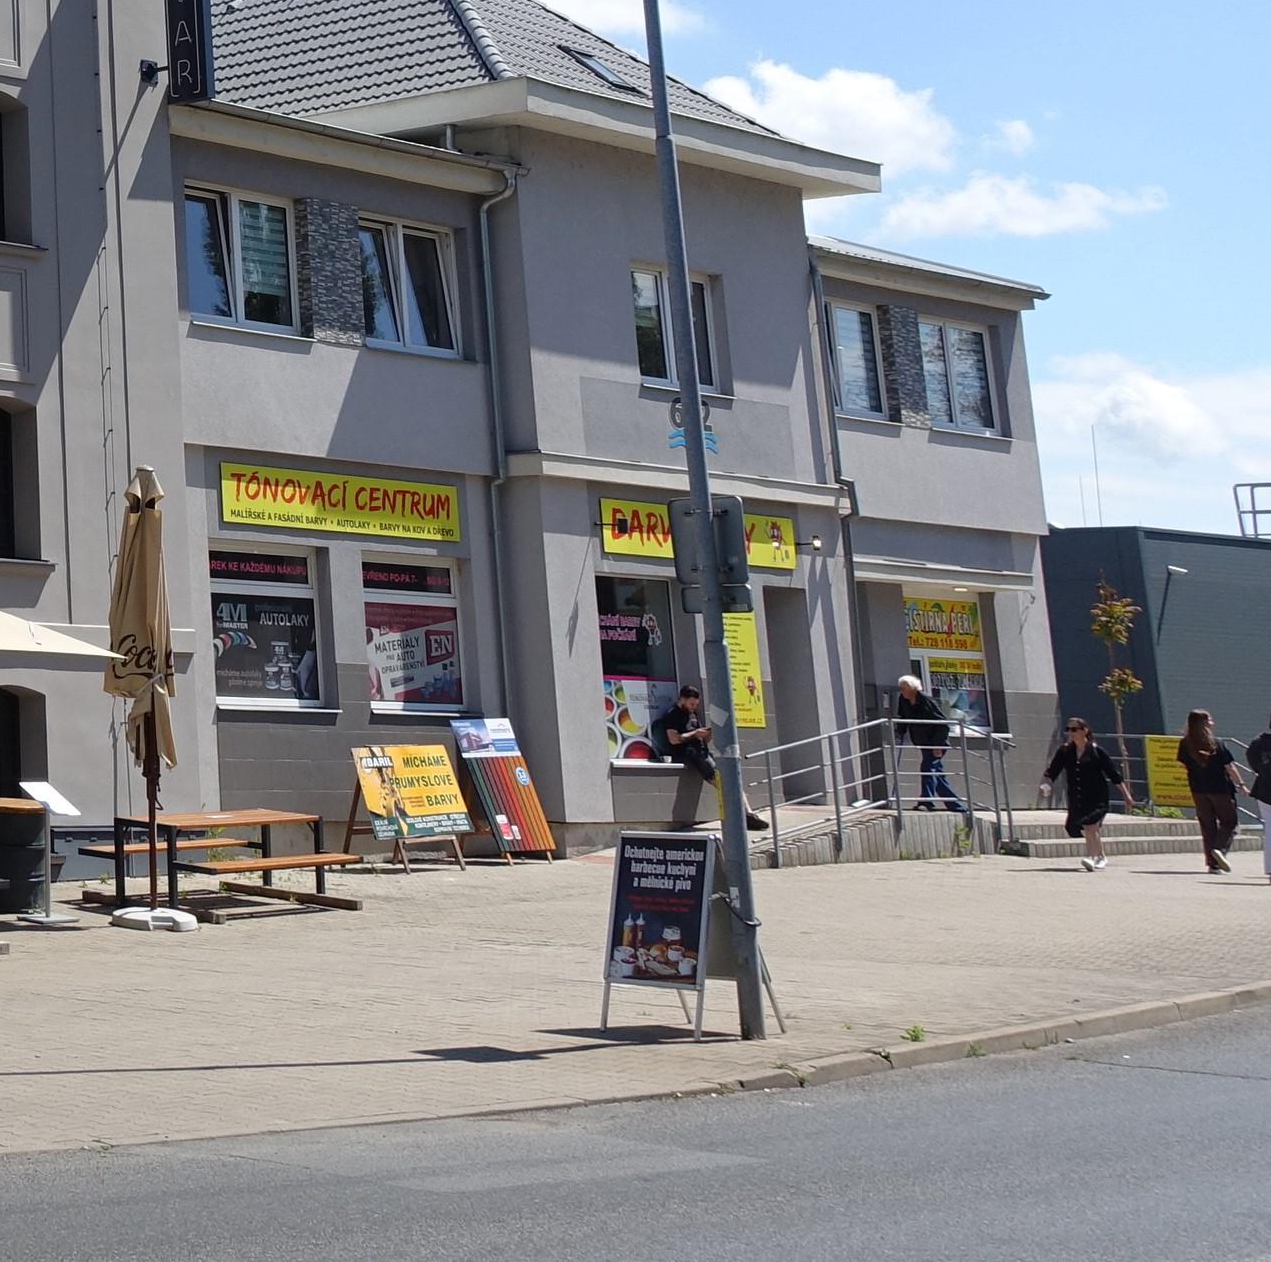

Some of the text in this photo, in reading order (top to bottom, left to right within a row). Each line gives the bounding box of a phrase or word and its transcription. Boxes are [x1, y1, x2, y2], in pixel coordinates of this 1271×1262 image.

[230, 471, 451, 521] TÓNOVACÍ CENTRUM
[305, 516, 328, 526] BARVY
[336, 519, 370, 530] AUTOLAKY
[379, 523, 401, 532] BARVY
[402, 525, 412, 534] NA
[259, 612, 309, 627] AUTOLAKY
[396, 652, 415, 661] AUTO
[402, 753, 447, 769] MÍCHÁME
[426, 793, 459, 807] BARVY
[624, 844, 664, 861] Ochutnejte
[631, 859, 666, 873] barbecue
[633, 878, 638, 887] a
[675, 878, 692, 892] pivo
